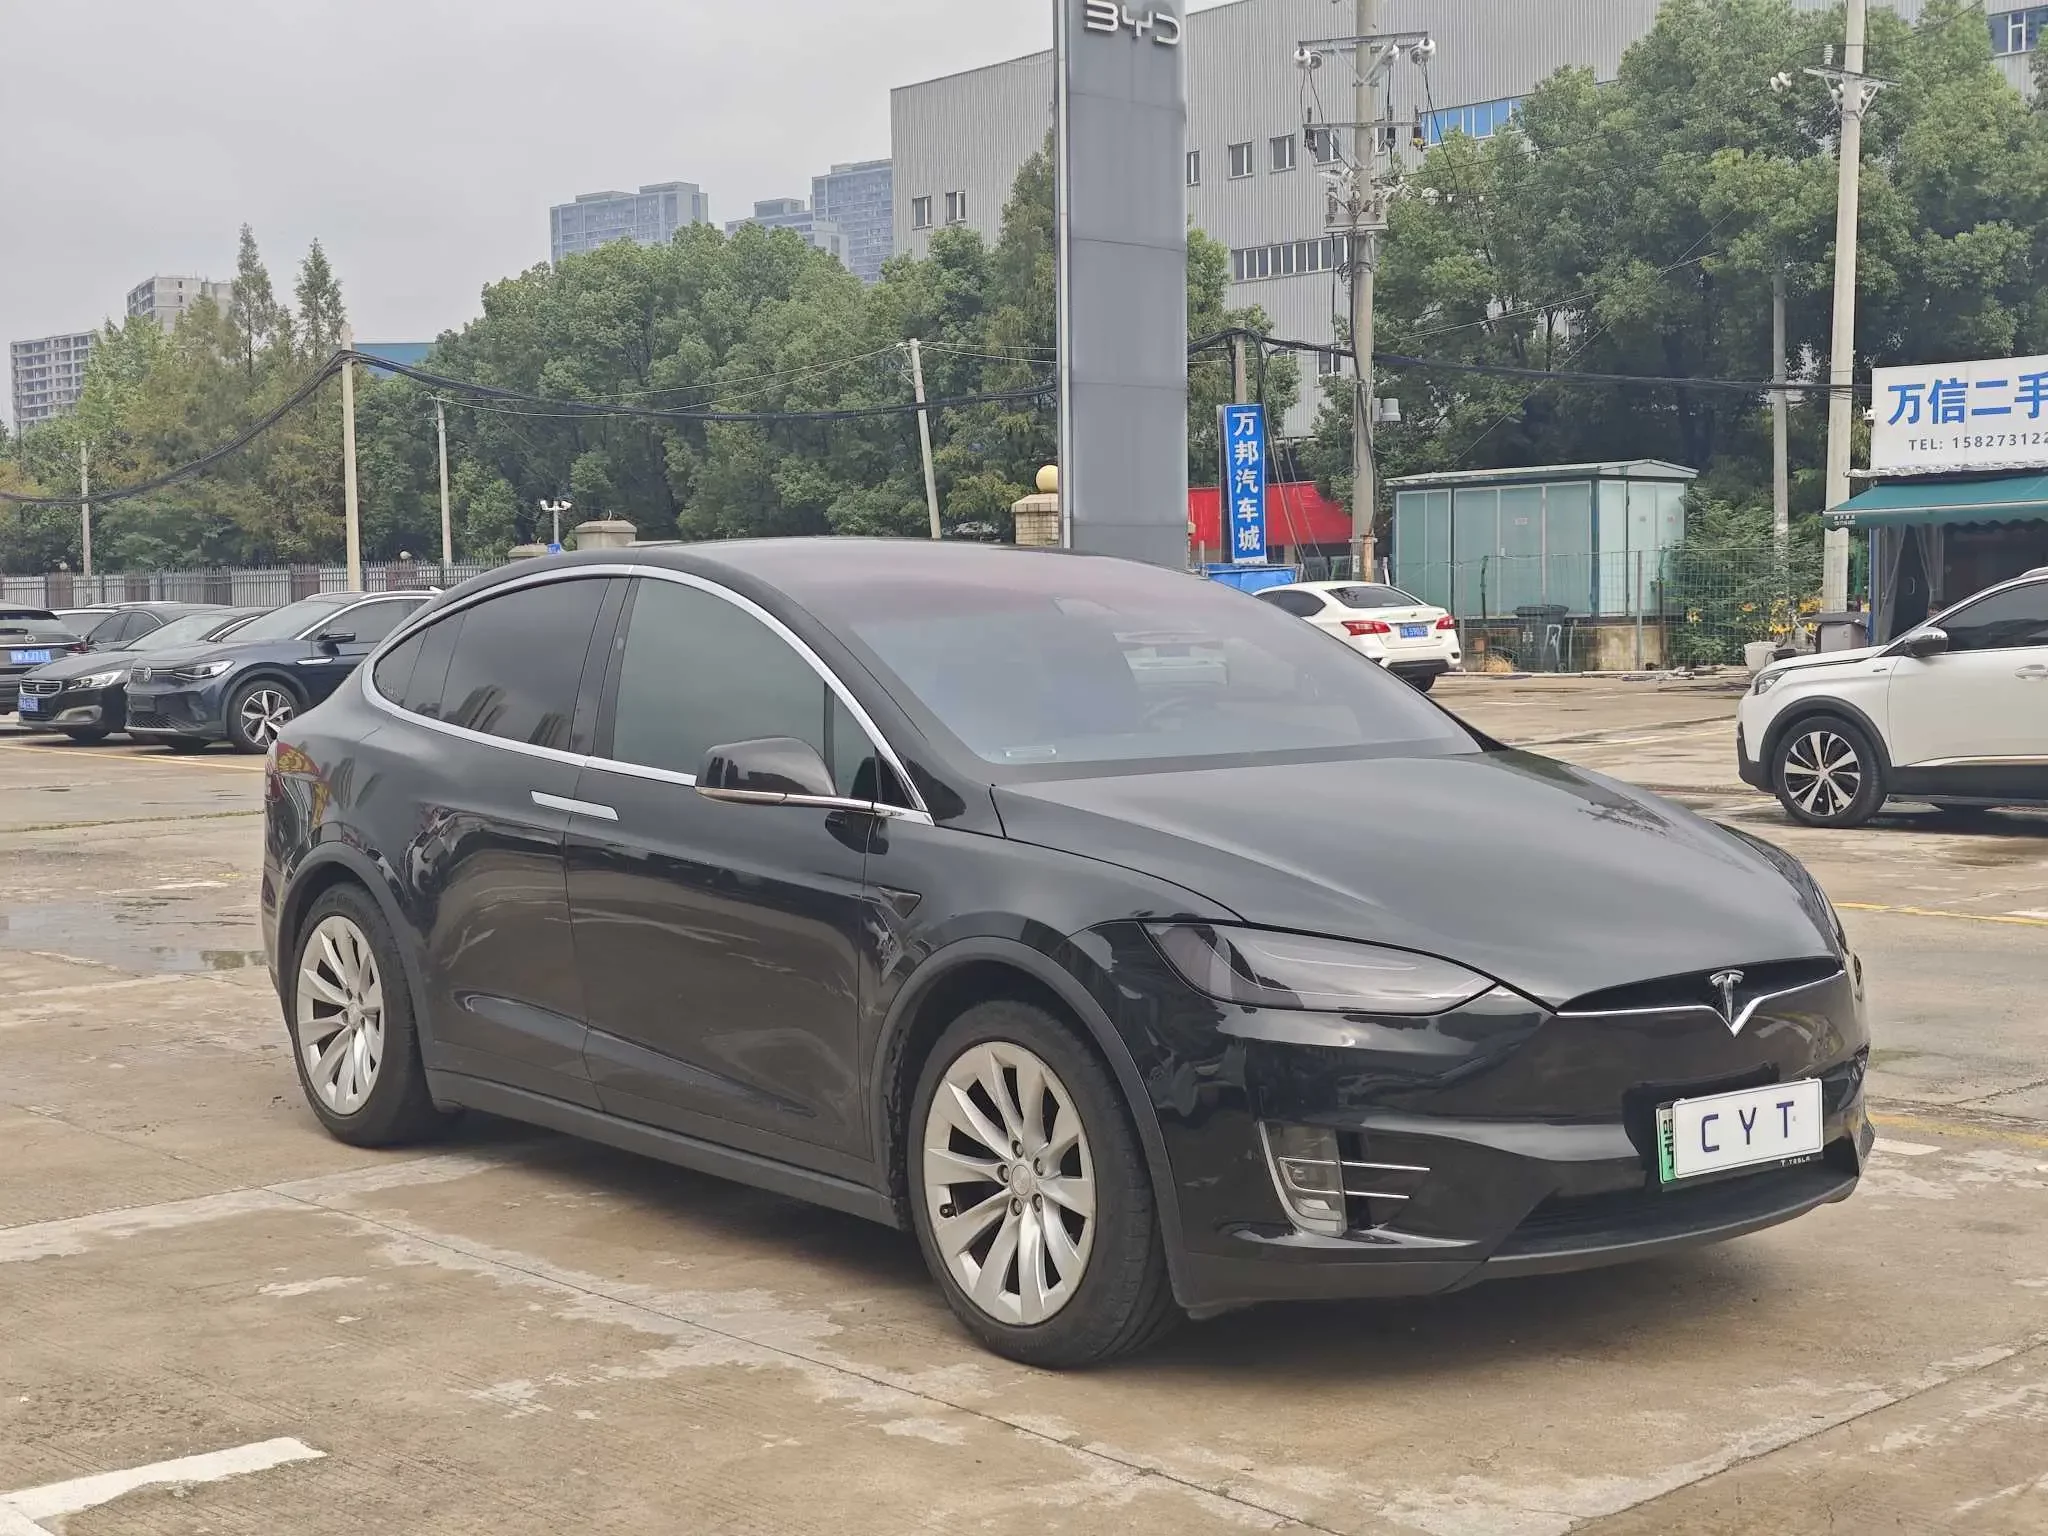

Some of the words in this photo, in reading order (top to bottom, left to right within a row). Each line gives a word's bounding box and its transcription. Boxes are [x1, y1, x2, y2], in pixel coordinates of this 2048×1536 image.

[1086, 0, 1180, 45] BYD
[1908, 438, 1944, 451] TEL:
[1232, 412, 1260, 551] 万邦汽车城
